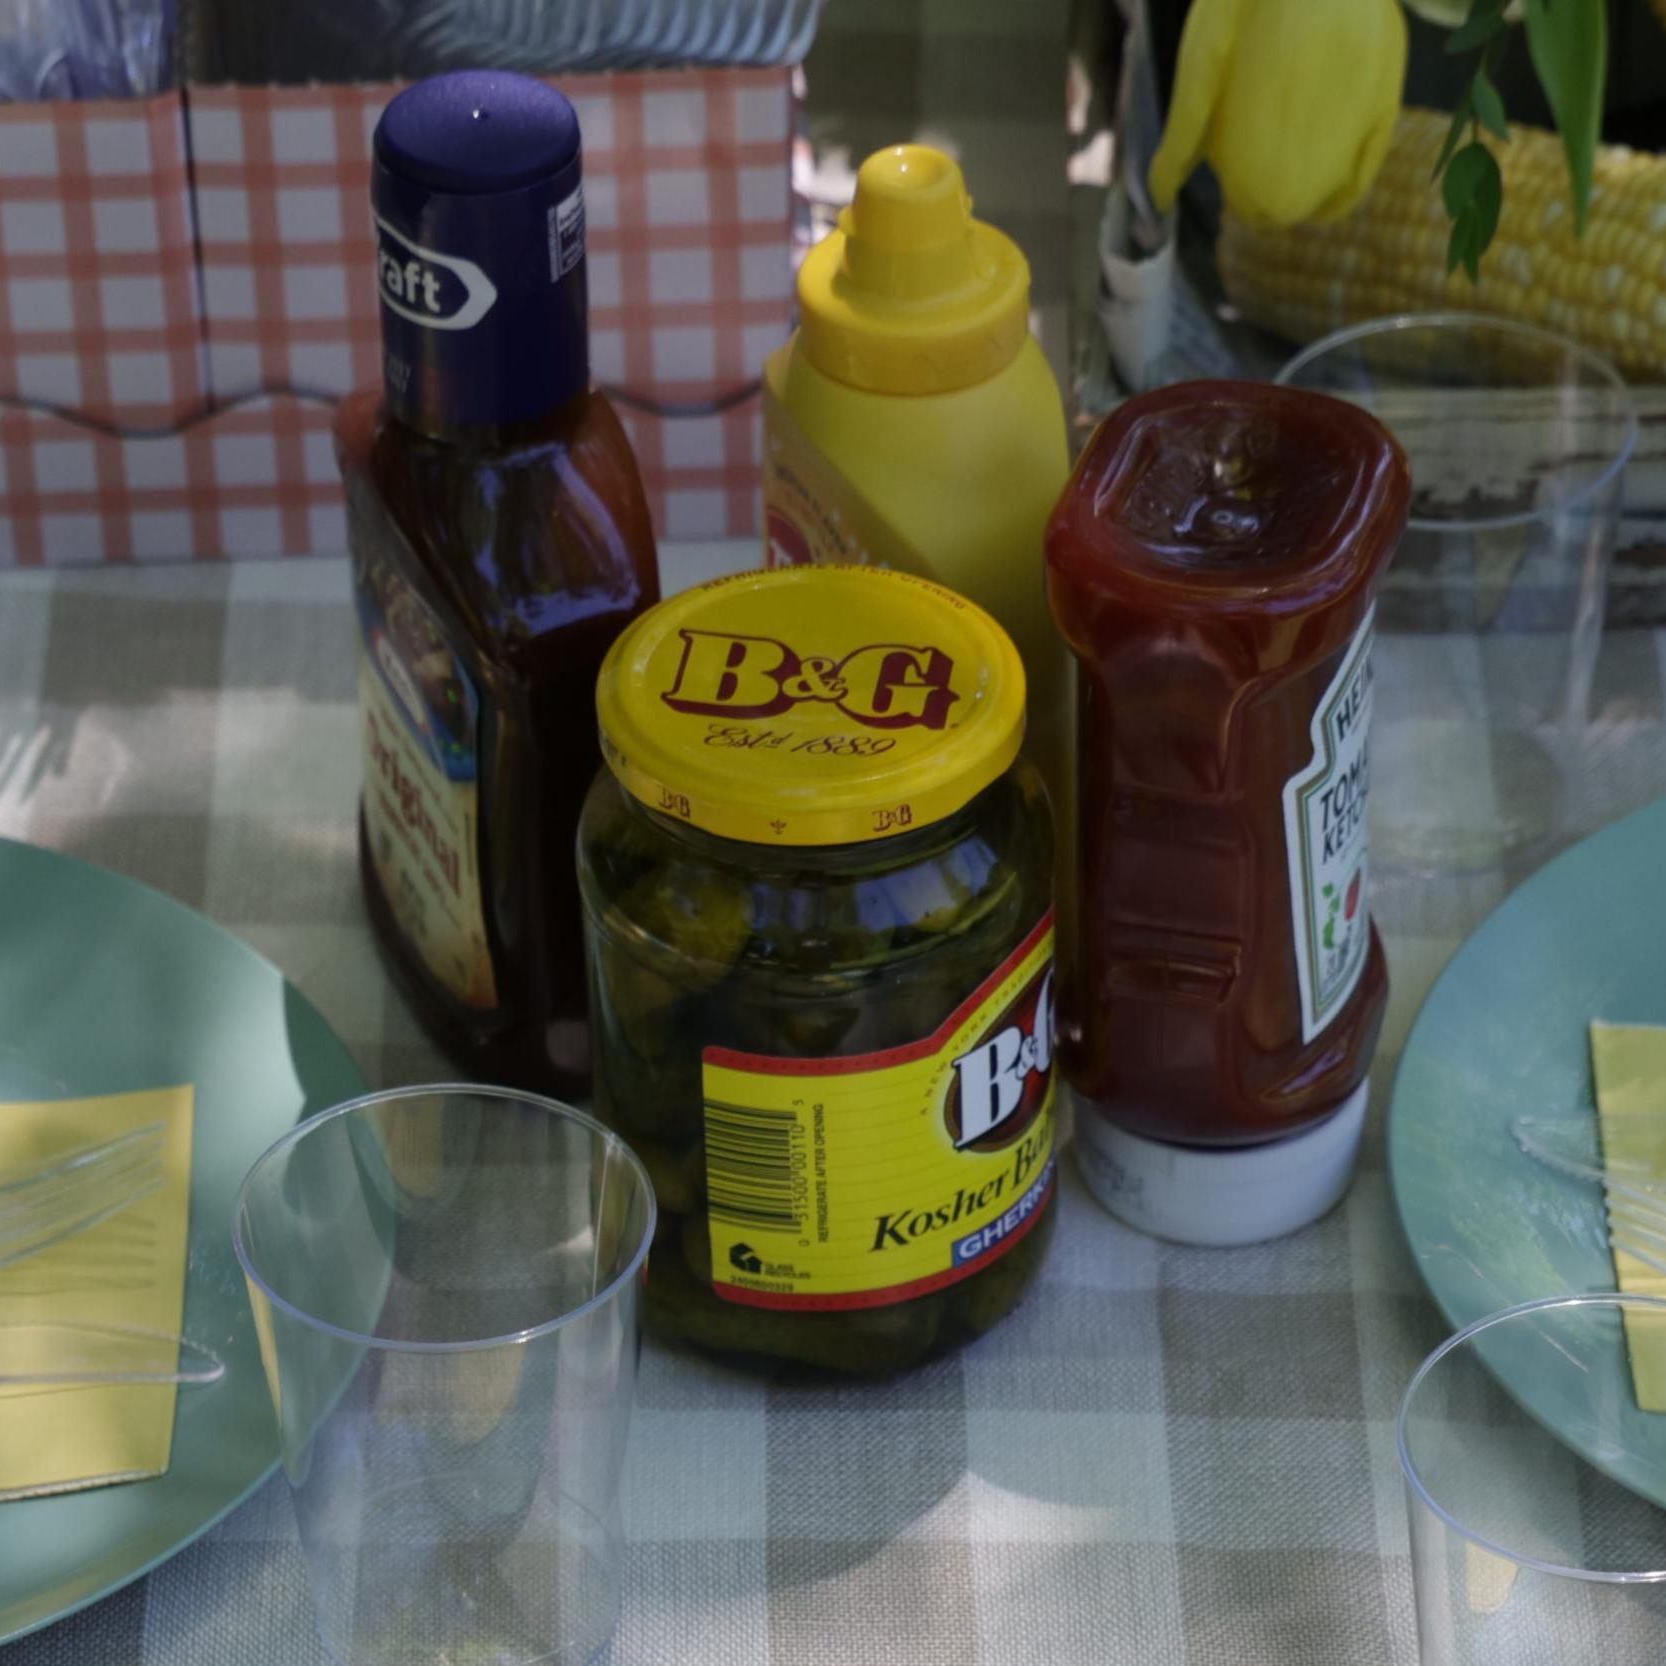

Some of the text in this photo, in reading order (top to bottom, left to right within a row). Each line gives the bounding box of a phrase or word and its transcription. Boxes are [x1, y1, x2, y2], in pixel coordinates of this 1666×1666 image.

[378, 246, 441, 314] raft
[660, 628, 961, 731] B&G
[1335, 654, 1374, 742] HEIN
[790, 735, 898, 757] 1889
[1319, 734, 1369, 833] TOMA
[1321, 788, 1368, 866] KETC
[813, 1103, 829, 1243] REFRIGERATE AFTER OPENING
[868, 1168, 1010, 1253] Kosher
[958, 1159, 1054, 1260] GHERK
